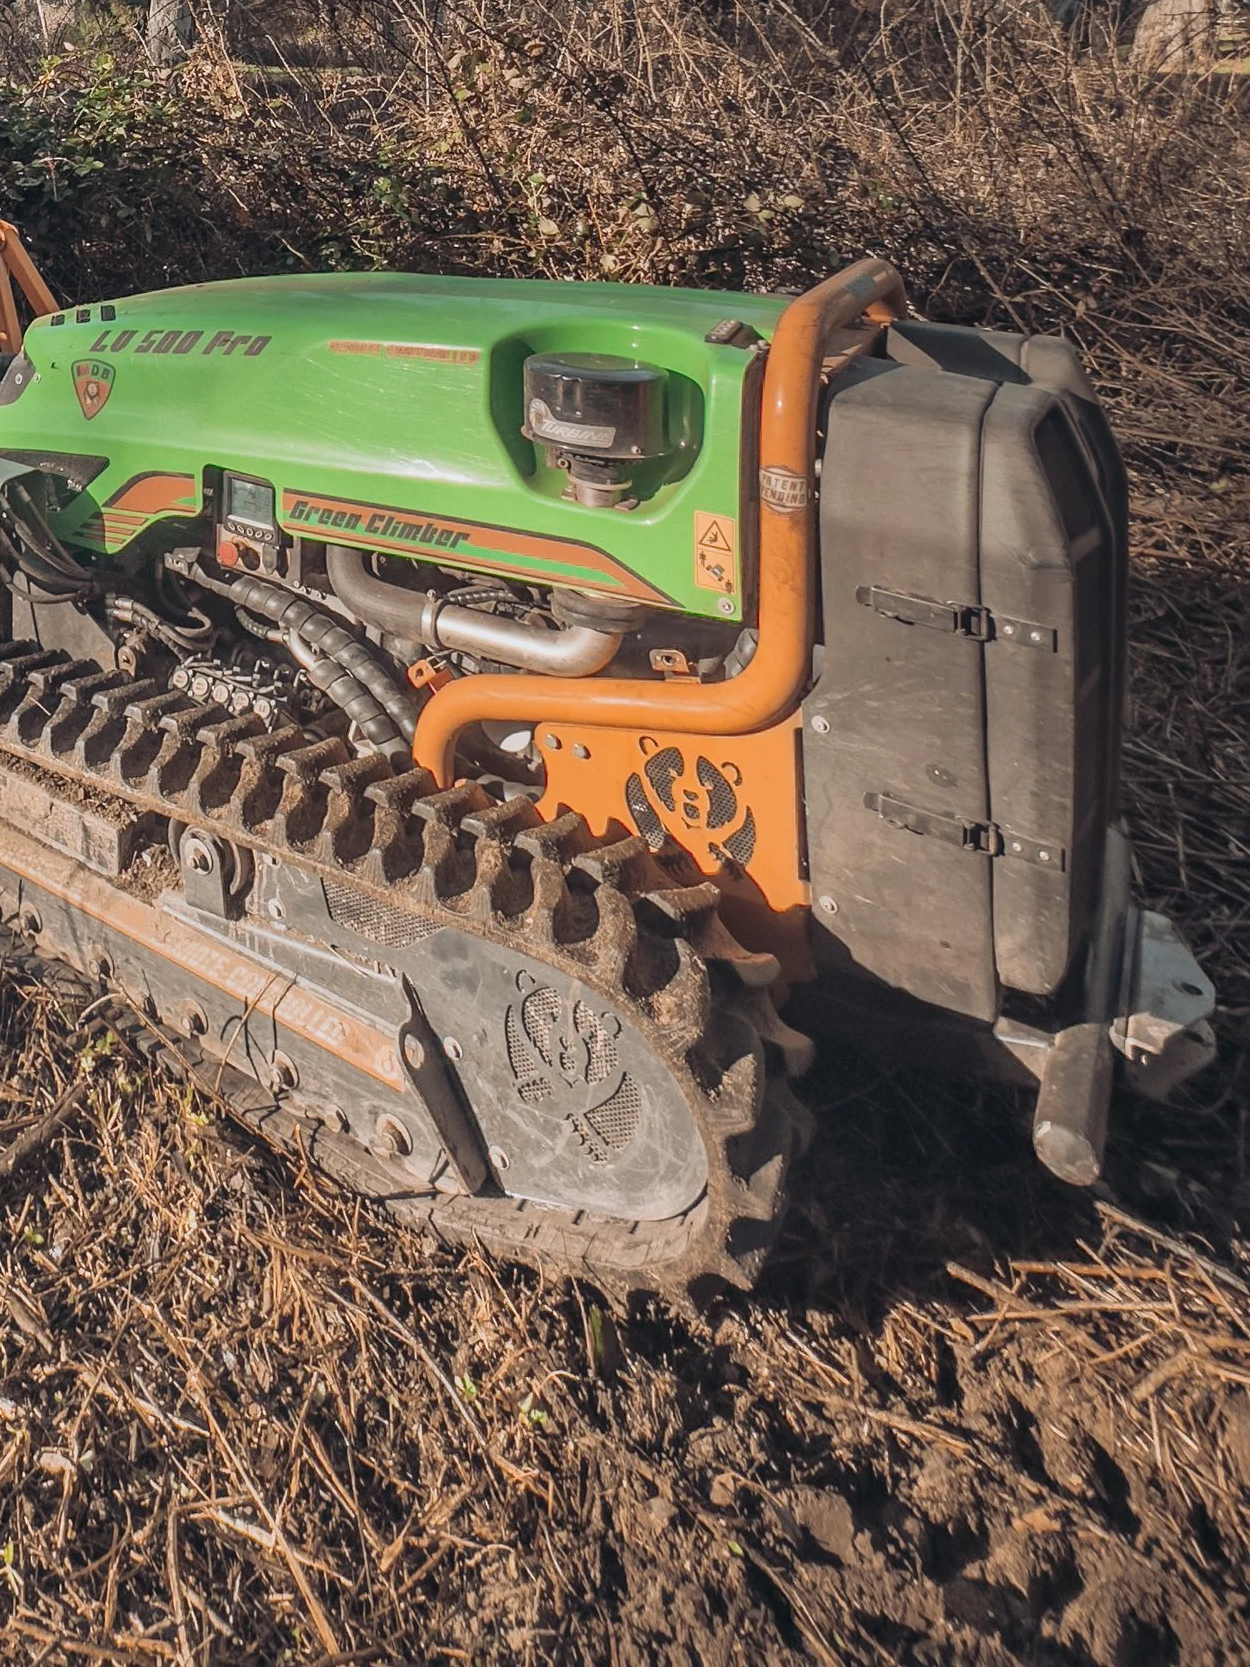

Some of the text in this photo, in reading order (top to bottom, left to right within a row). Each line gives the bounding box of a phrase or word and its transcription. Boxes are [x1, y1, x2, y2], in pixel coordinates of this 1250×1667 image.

[134, 329, 204, 354] 500
[201, 330, 273, 356] Pro
[541, 419, 611, 443] TURBINE
[760, 472, 806, 493] PATENT
[760, 484, 806, 505] PENDING
[289, 500, 362, 531] Green
[364, 513, 470, 549] Climber
